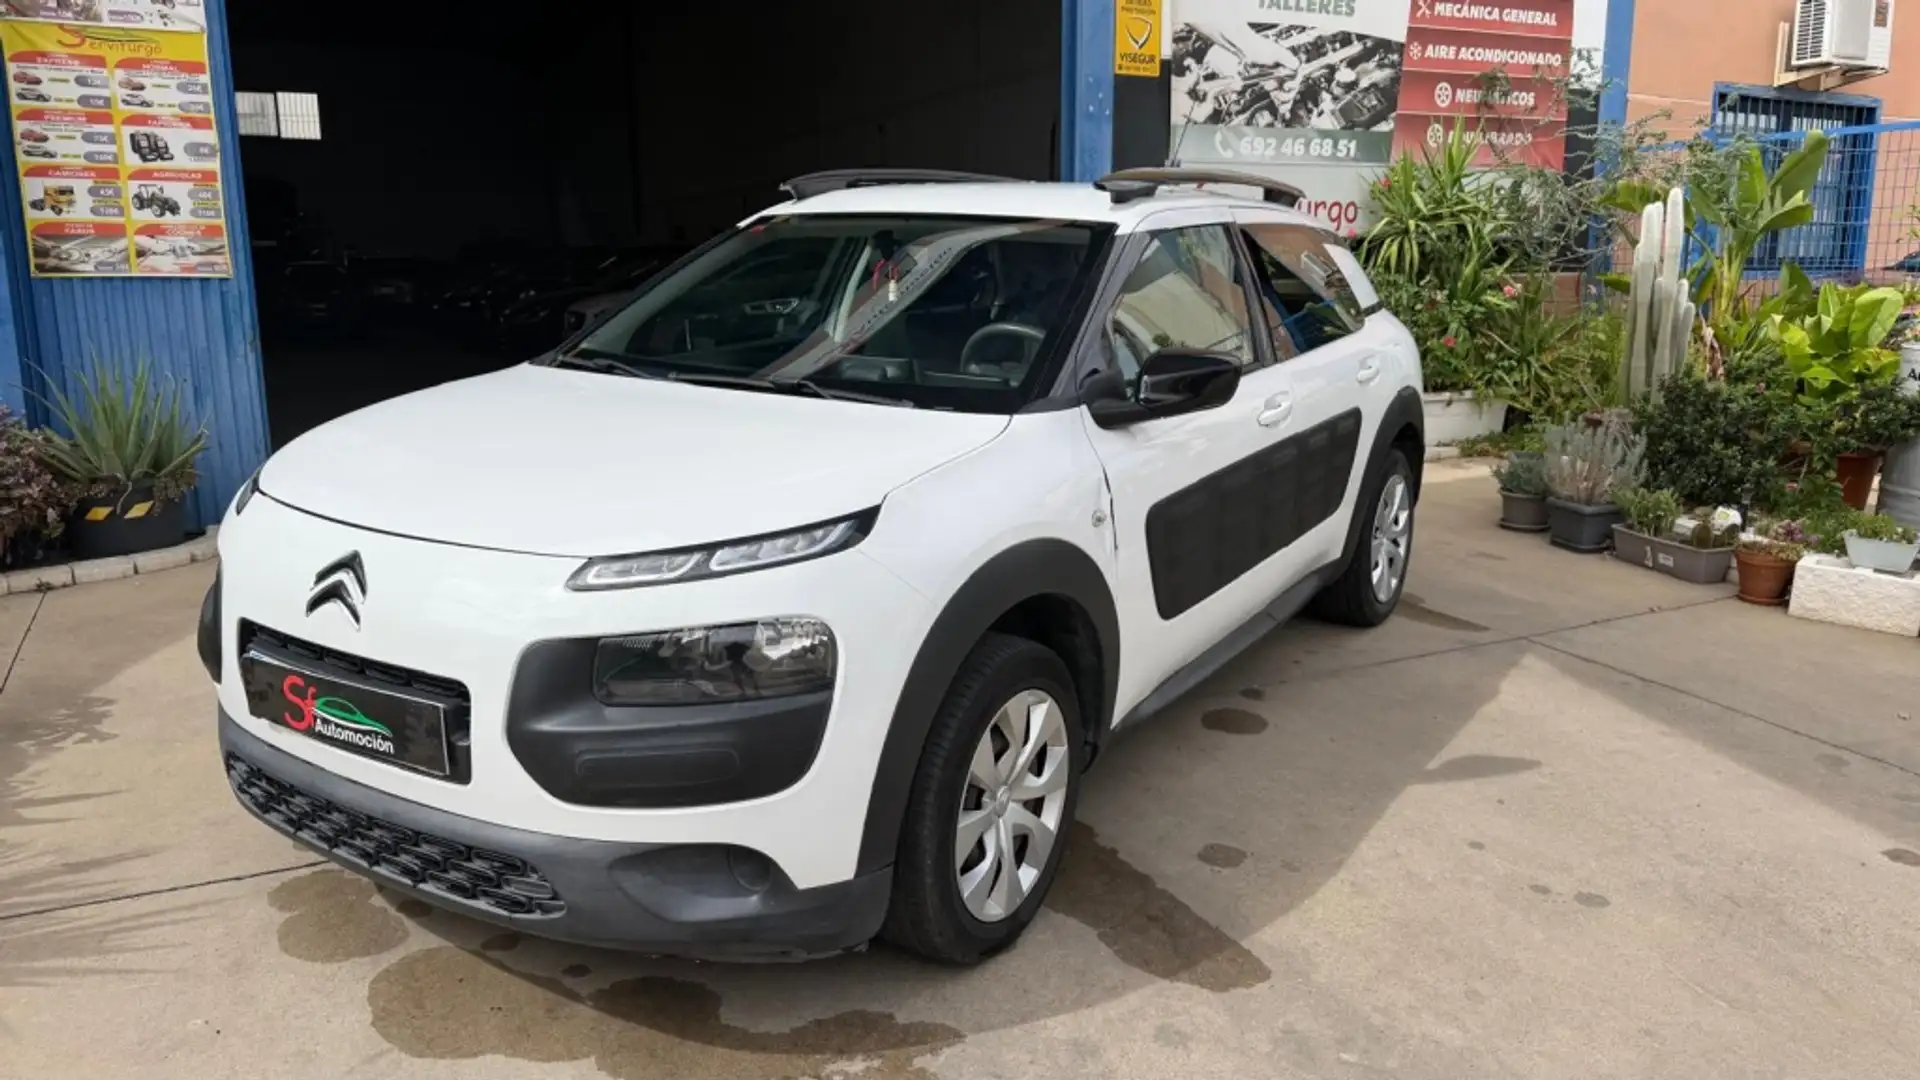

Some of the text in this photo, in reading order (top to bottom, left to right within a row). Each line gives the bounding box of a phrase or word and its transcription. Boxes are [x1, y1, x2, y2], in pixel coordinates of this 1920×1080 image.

[1434, 0, 1557, 26] MECÁNICA GENERAL
[1424, 44, 1562, 66] AIRE ACONDICIONADO
[1240, 136, 1357, 158] 692 46 68 51
